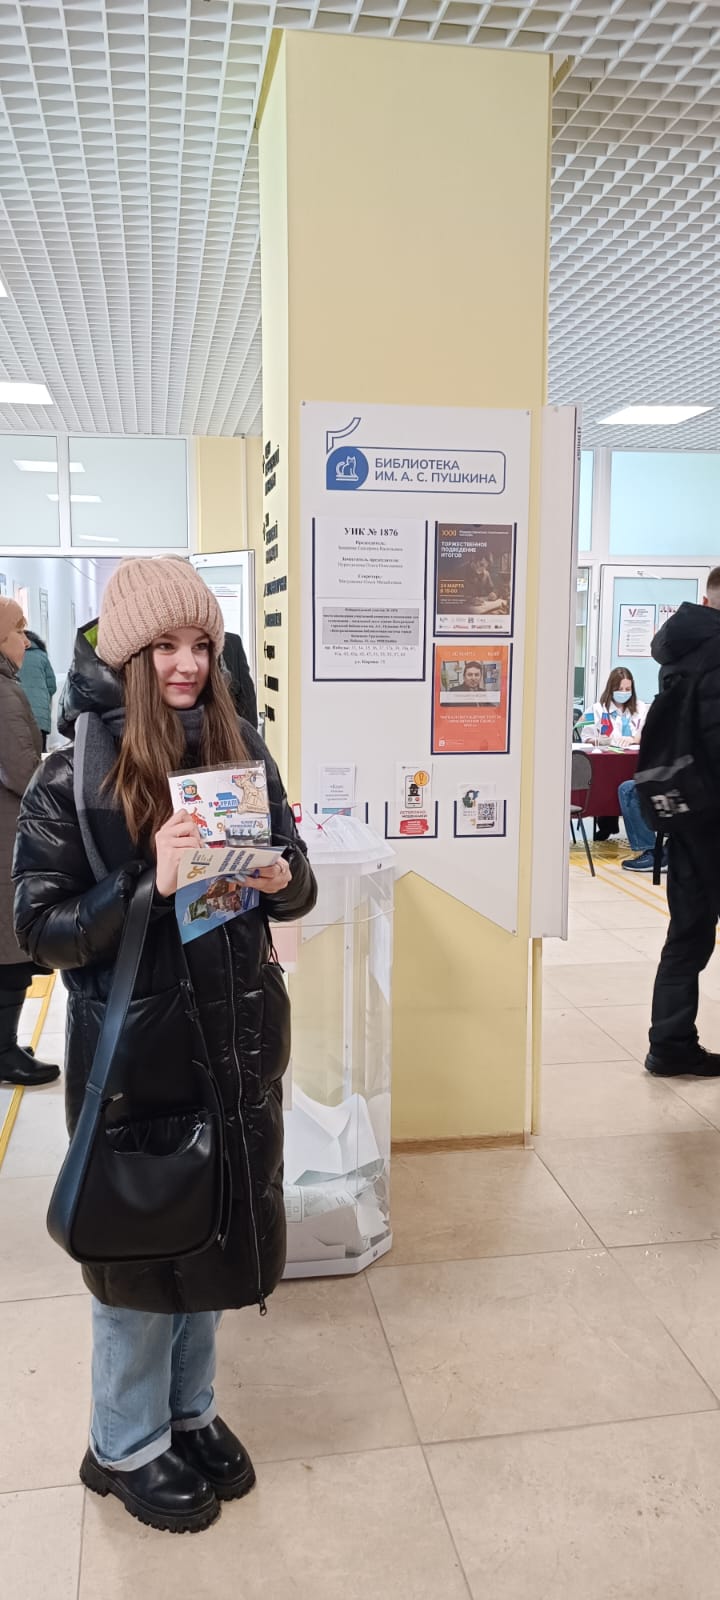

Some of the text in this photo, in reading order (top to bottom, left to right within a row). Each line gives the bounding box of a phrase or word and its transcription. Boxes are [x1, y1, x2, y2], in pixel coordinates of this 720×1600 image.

[375, 458, 460, 470] БИБЛИОТЕКА
[375, 471, 497, 484] ИМ. А. С. ПУШКИНА
[344, 527, 365, 536] УИК
[380, 528, 398, 537] 1876
